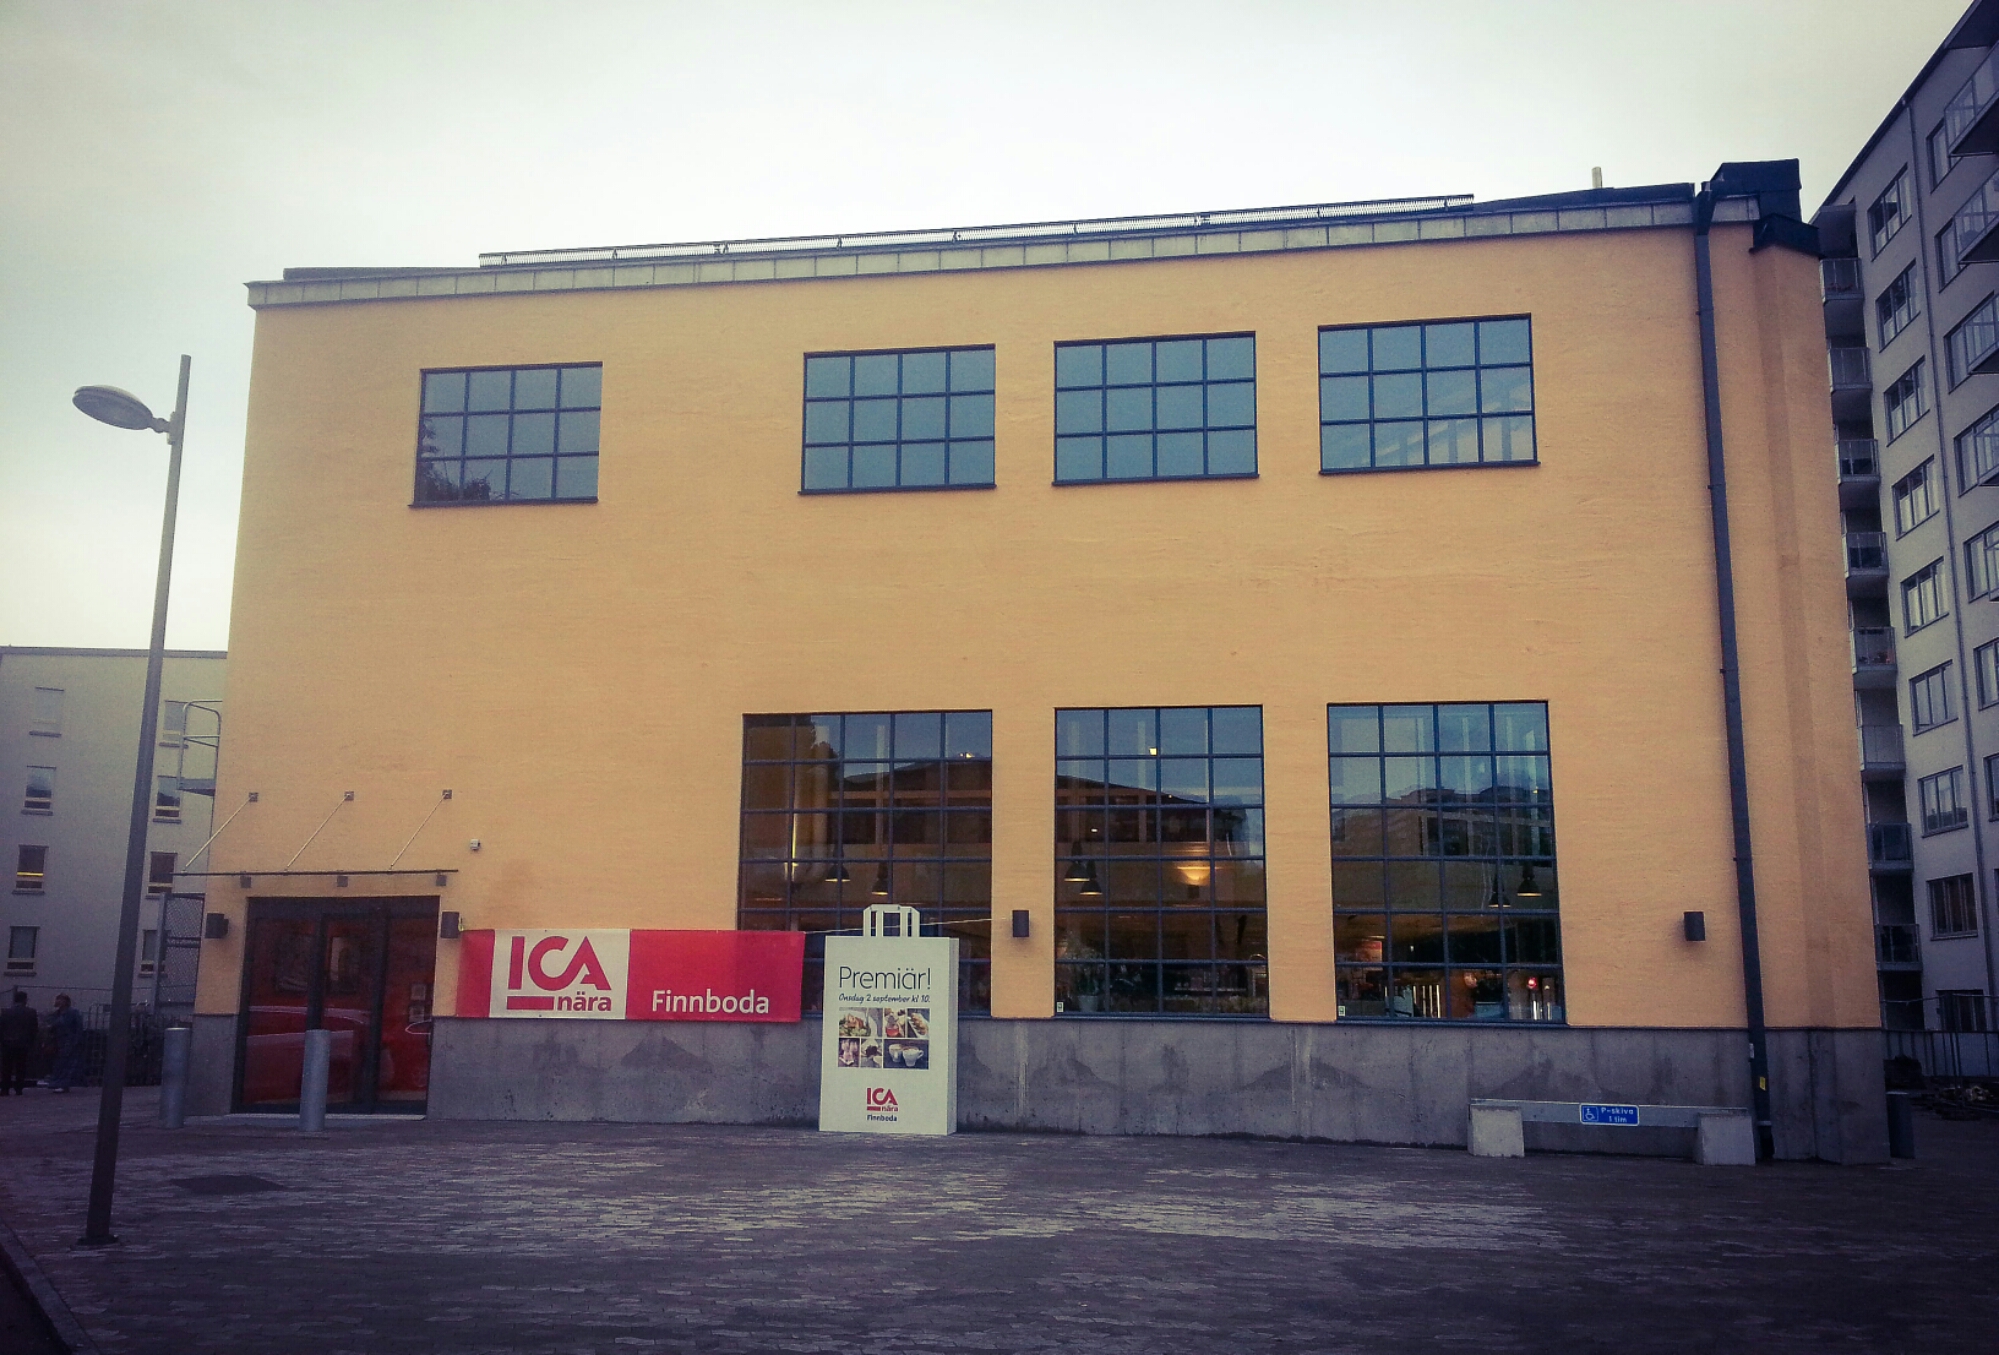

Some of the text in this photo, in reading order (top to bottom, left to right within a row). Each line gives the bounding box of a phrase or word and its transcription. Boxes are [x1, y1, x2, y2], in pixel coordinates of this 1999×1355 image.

[507, 935, 612, 991] ICA
[839, 966, 931, 990] Premiär!
[557, 991, 612, 1011] nära
[652, 988, 769, 1014] Finnboda
[838, 993, 865, 1005] Onsdag
[866, 994, 872, 1002] 2
[872, 994, 911, 1004] september
[866, 1087, 898, 1105] ICA
[866, 1114, 897, 1122] Finnboda
[1600, 1107, 1634, 1115] P-skiva
